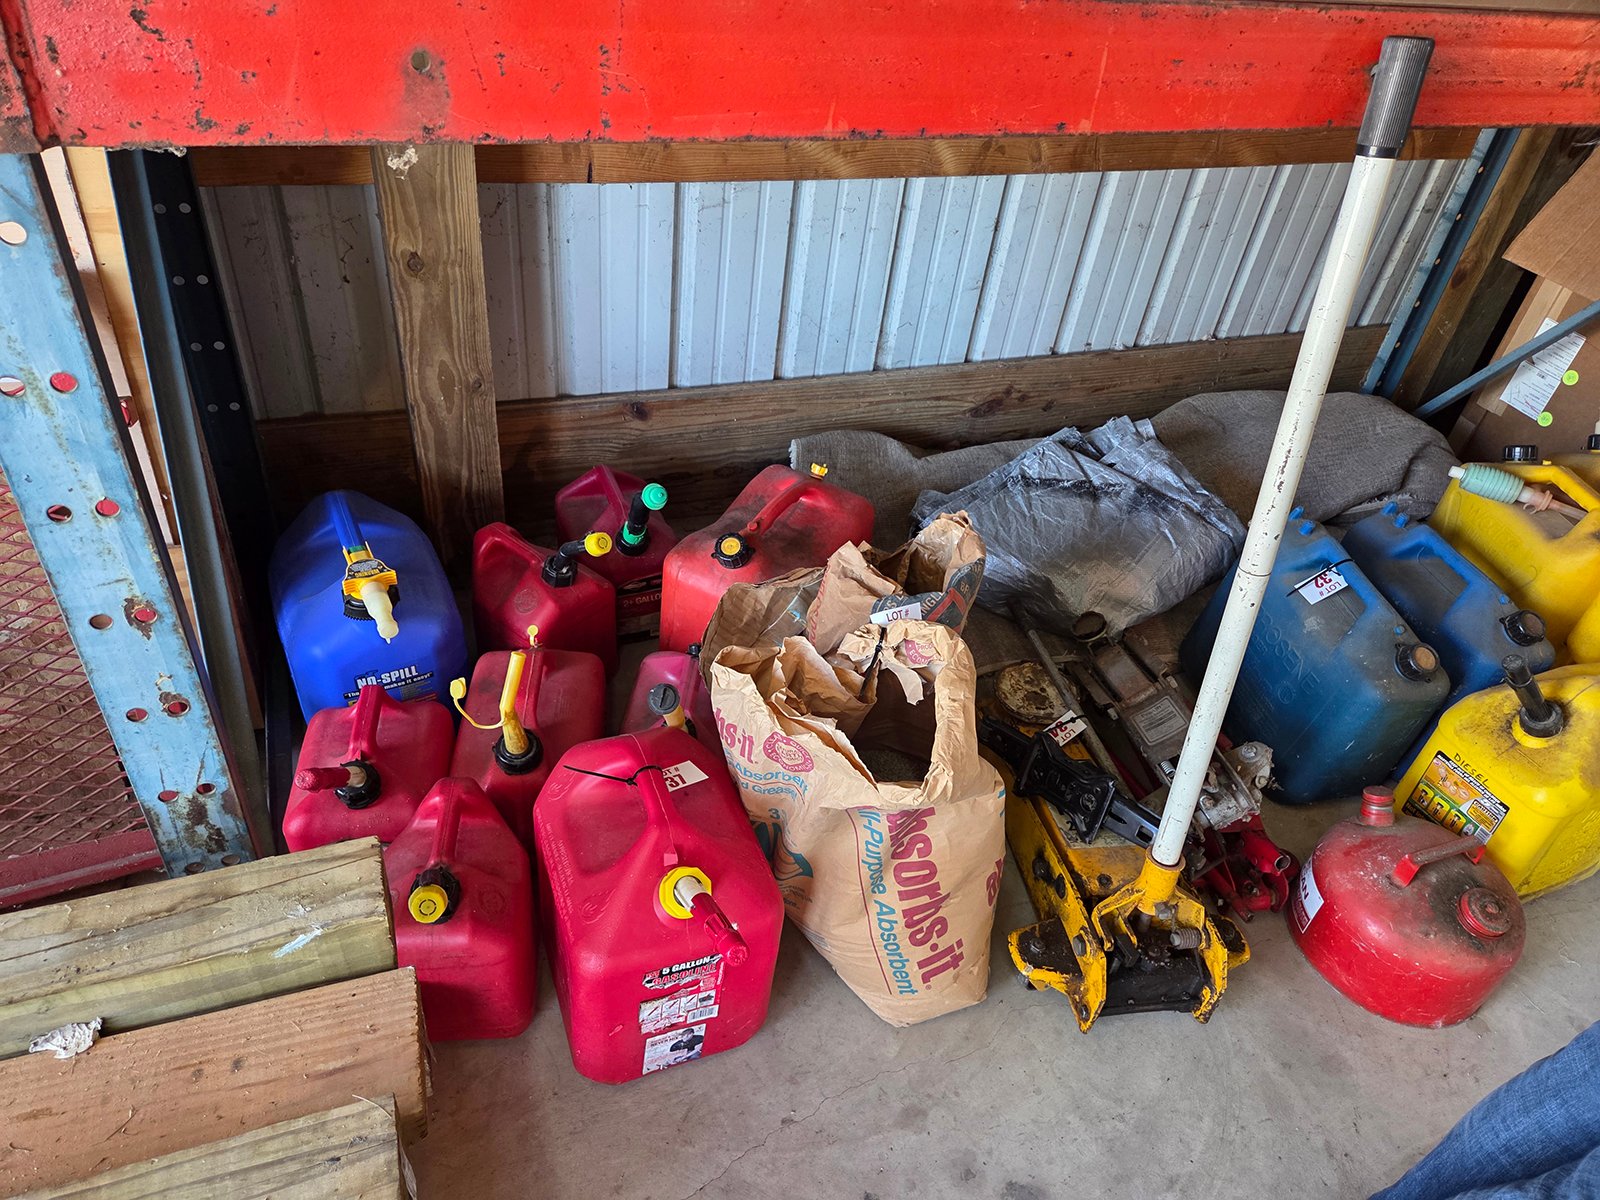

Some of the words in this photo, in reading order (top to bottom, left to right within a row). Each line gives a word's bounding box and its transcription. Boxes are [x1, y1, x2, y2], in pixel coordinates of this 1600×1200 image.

[1325, 581, 1342, 593] LOT
[635, 592, 662, 605] GALLO
[885, 609, 903, 622] LOT
[356, 665, 419, 689] NO-SPILL
[1061, 728, 1076, 742] LOT
[1454, 752, 1490, 789] DIESEL
[664, 773, 687, 788] 37
[858, 808, 887, 896] ll-Purpose
[873, 899, 919, 996] Absorbent
[652, 963, 717, 985] GASOLINE
[661, 967, 670, 975] 5
[671, 956, 711, 973] GALLON
